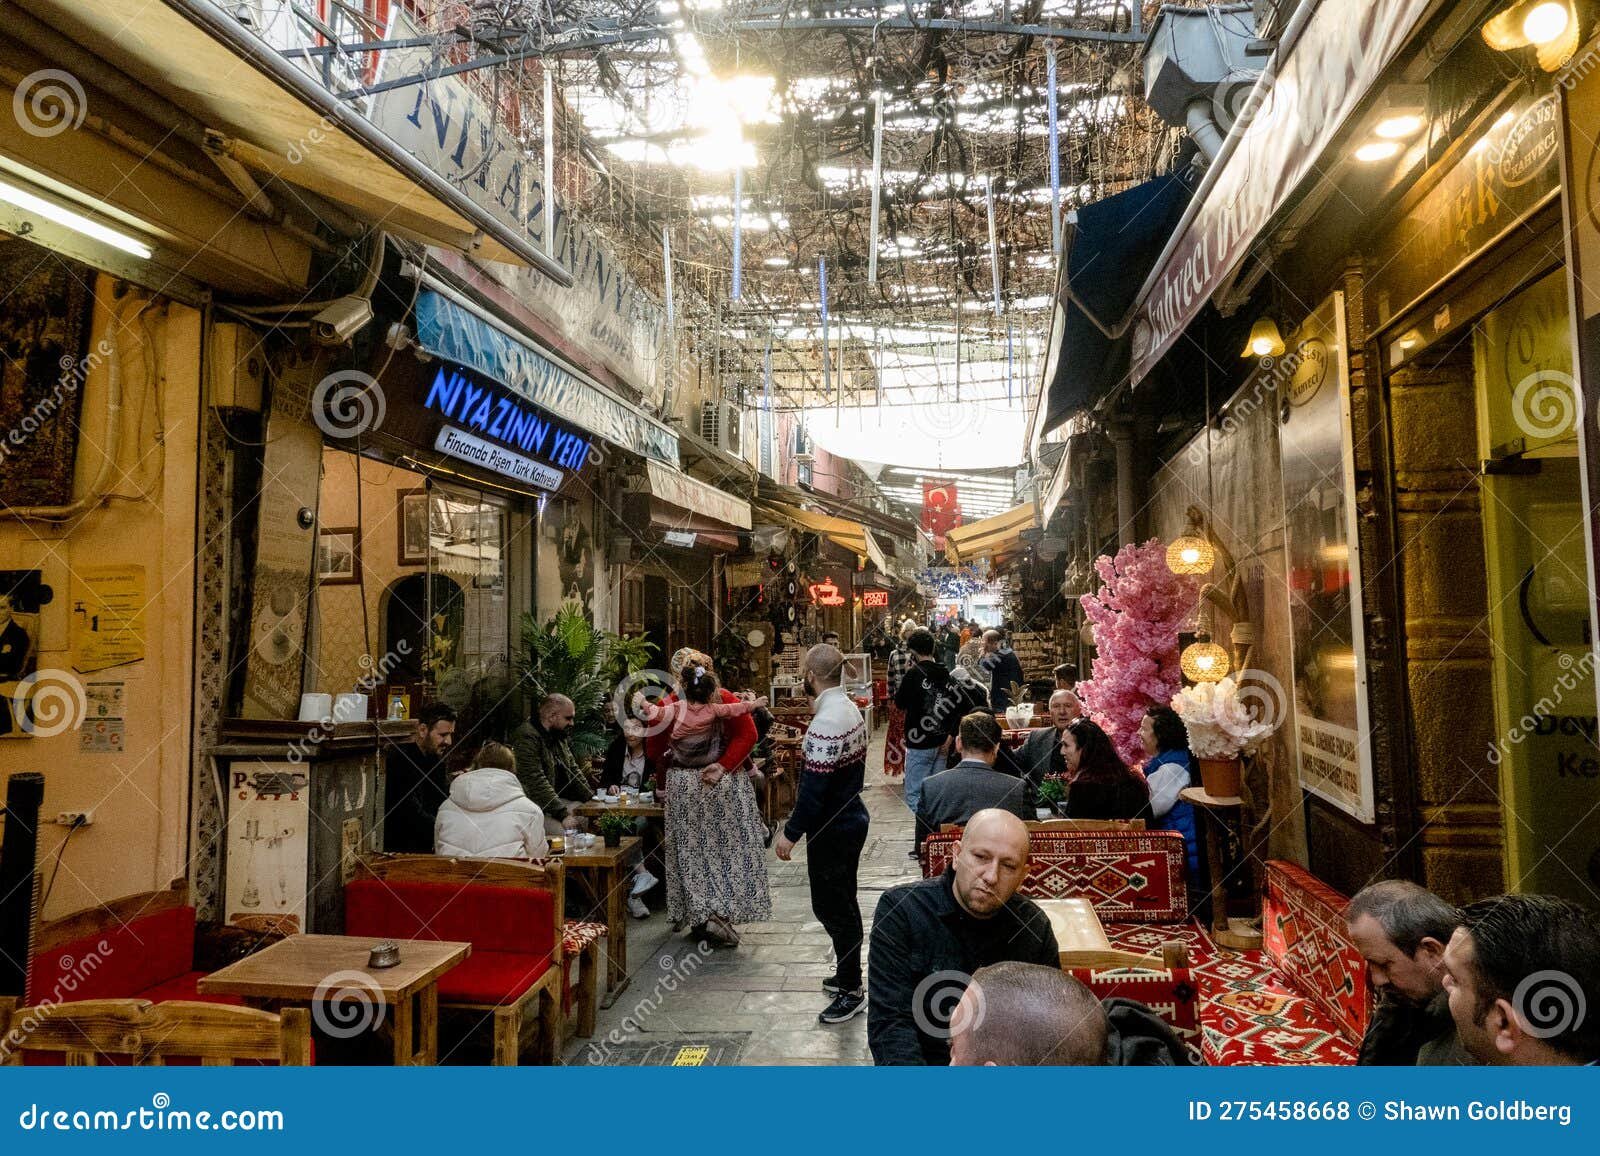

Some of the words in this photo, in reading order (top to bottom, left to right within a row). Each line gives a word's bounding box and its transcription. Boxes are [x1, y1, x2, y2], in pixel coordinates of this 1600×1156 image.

[444, 432, 487, 461] Fincanda
[488, 450, 512, 470] Pişen
[512, 458, 530, 478] Türk
[530, 466, 558, 488] Kahvesi
